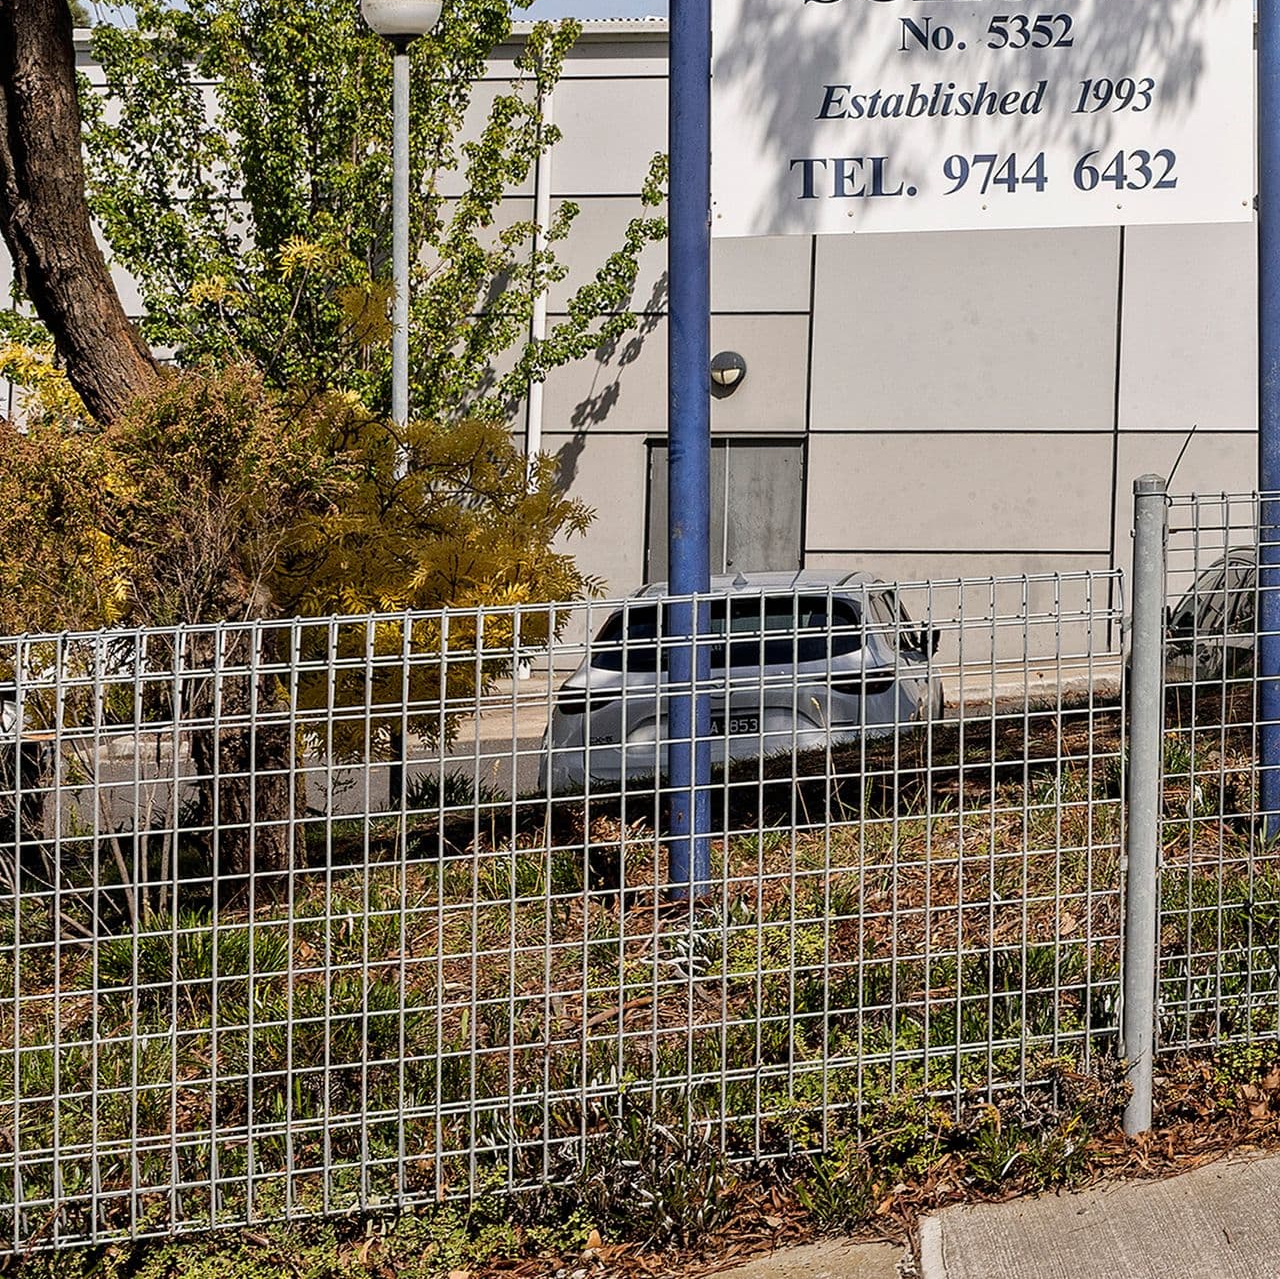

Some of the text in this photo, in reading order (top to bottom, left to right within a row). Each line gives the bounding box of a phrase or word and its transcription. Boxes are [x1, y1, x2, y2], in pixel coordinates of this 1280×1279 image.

[898, 13, 1074, 51] No. 5352
[814, 77, 1155, 120] Established 1993
[789, 149, 1178, 200] TEL. 9744 6432
